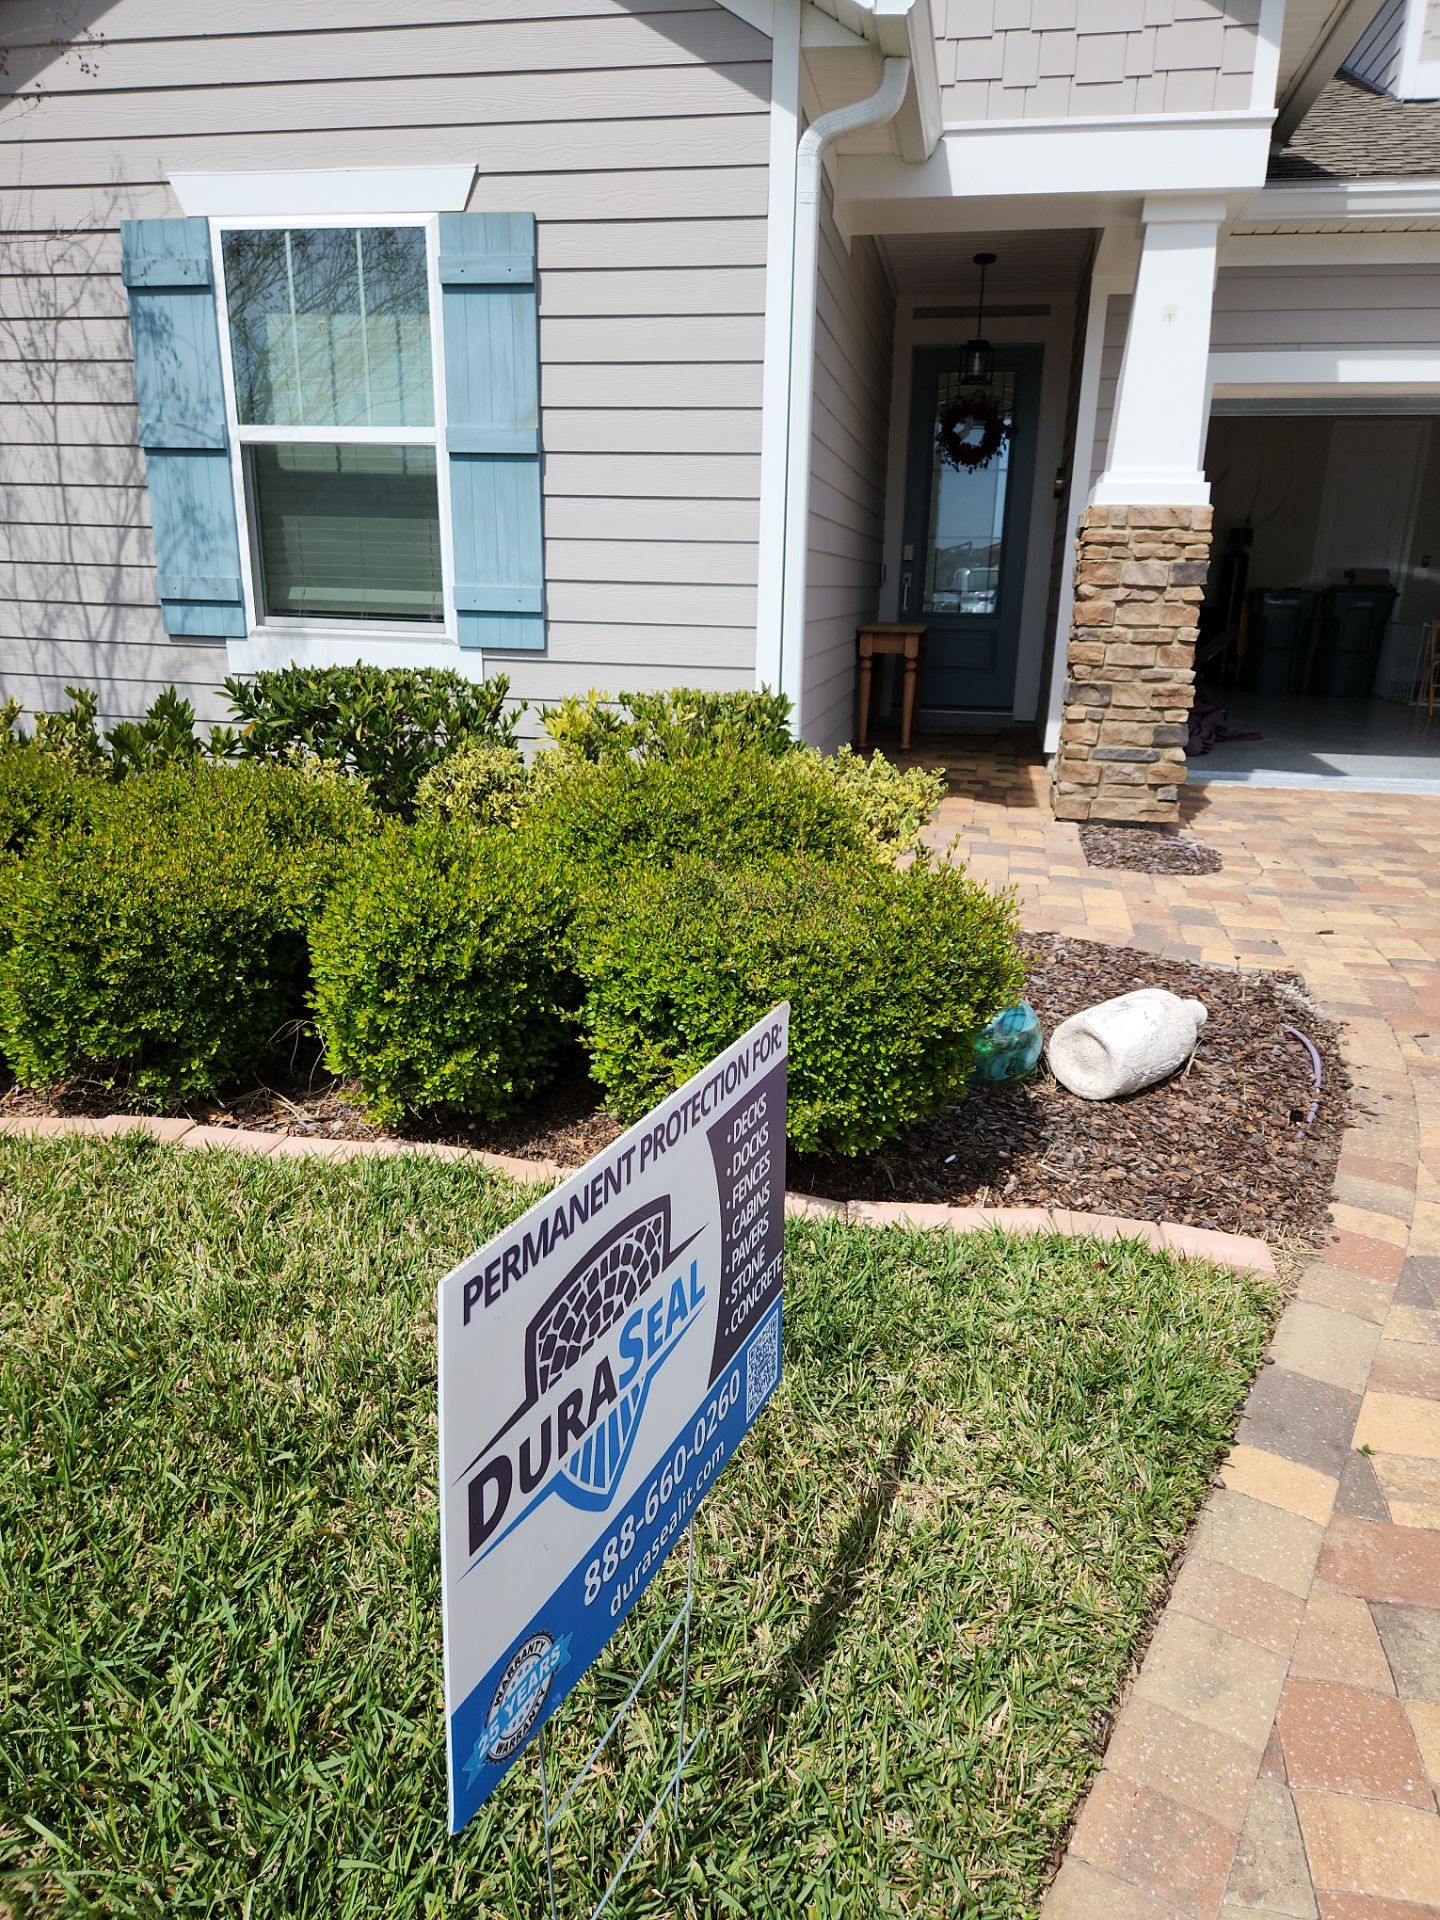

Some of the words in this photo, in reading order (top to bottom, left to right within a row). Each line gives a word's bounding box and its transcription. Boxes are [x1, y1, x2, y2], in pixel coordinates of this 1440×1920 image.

[733, 1092, 767, 1144] DECKS
[733, 1121, 769, 1177] DOCKS
[463, 1146, 635, 1326] PERMANENT
[640, 1054, 749, 1173] PROTECTION
[752, 1022, 783, 1073] FOR:
[732, 1150, 771, 1210] FENCES
[732, 1180, 770, 1241] CABINS
[732, 1211, 769, 1274] PAVERS
[730, 1250, 783, 1334] CONCRETE
[731, 1244, 766, 1303] STONE
[468, 1258, 706, 1558] DURASEAL
[583, 1368, 740, 1607] 888-660-0260
[610, 1441, 724, 1617] durasealit.com
[479, 1720, 500, 1758] 25
[504, 1644, 561, 1719] YEARS
[494, 1640, 546, 1708] WARRANTY
